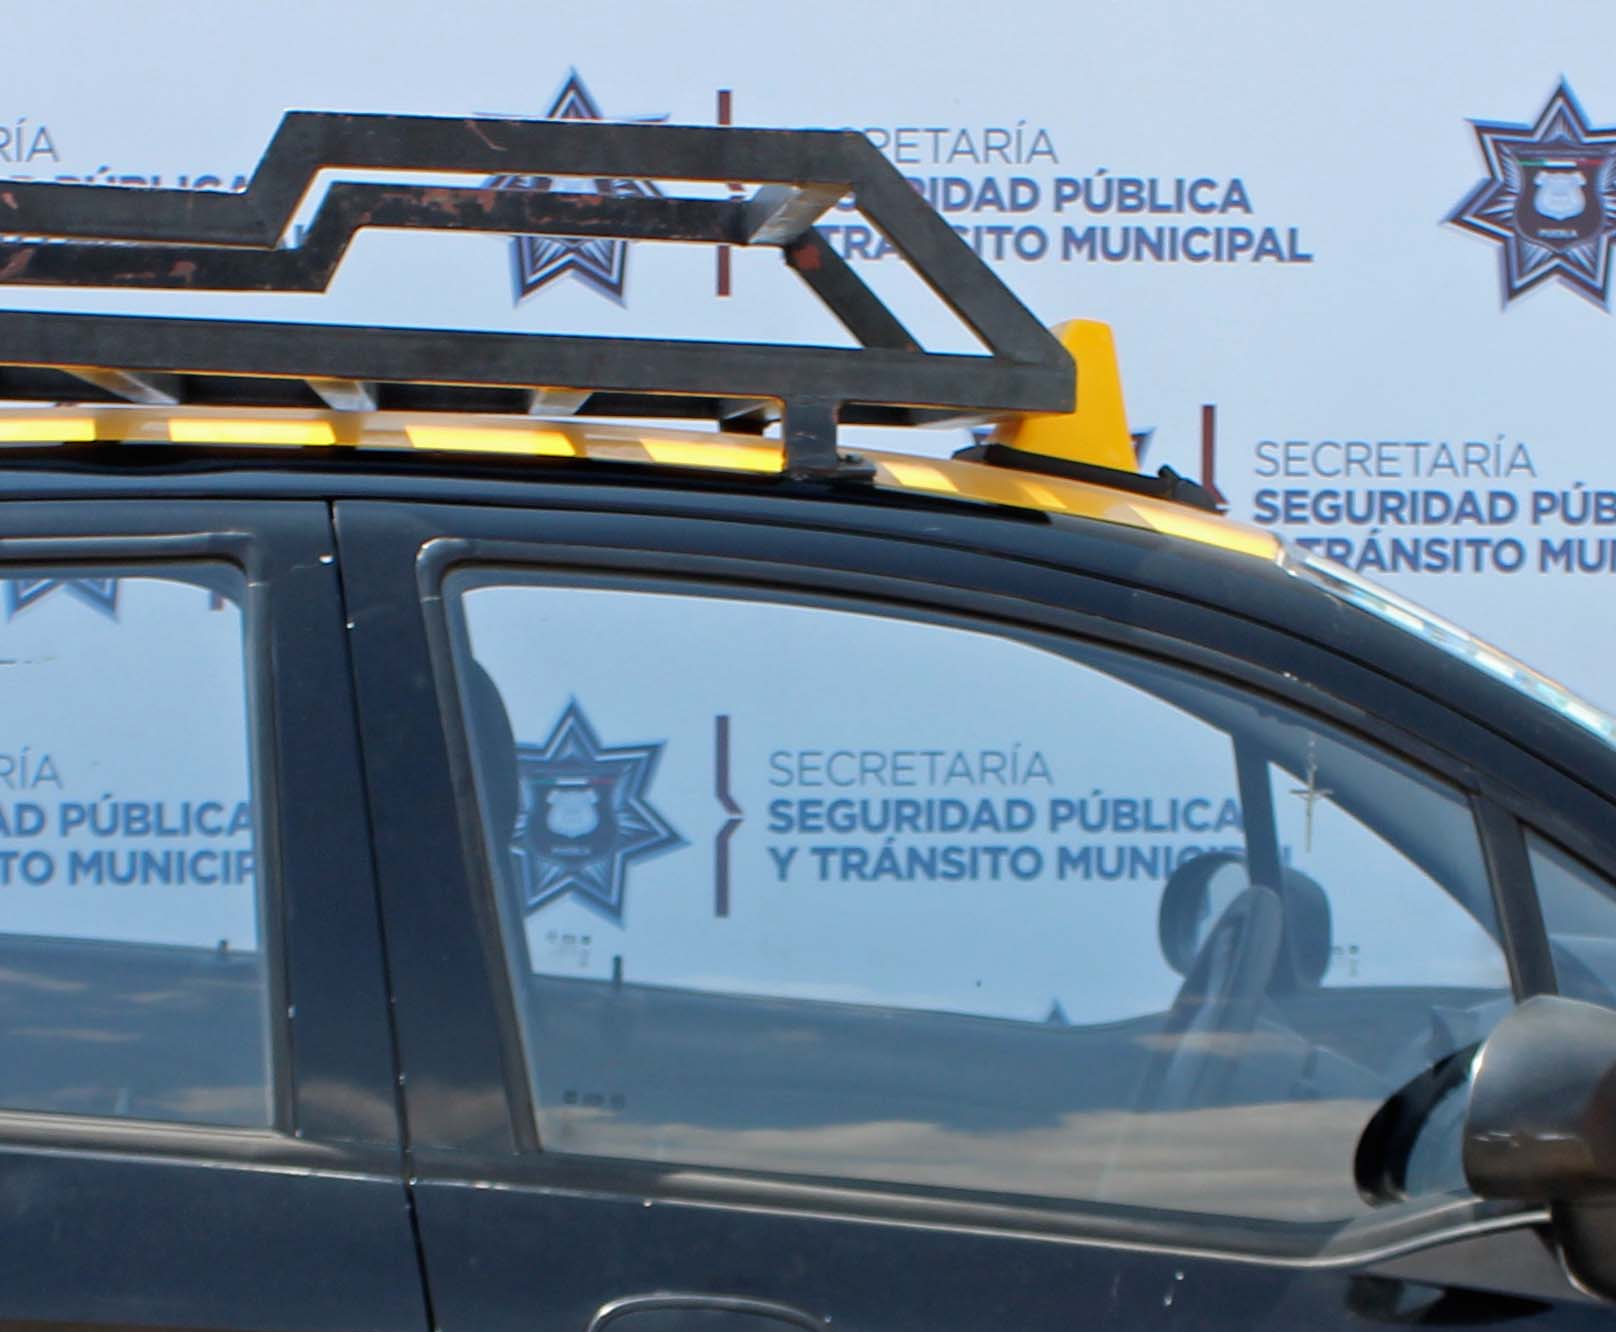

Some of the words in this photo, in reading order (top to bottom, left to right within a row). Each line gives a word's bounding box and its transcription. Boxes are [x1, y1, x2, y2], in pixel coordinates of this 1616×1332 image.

[862, 120, 1061, 164] ETARÍA
[1053, 167, 1253, 214] PÚBLICA
[1061, 225, 1314, 263] MUNICIPAL
[1254, 433, 1537, 478] SECRETARÍA
[1253, 488, 1519, 525] SEGURIDAD
[768, 742, 1054, 788] SECRETARÍA
[57, 794, 252, 839] PÚBLICA
[767, 797, 1036, 835] SEGURIDAD
[1049, 789, 1242, 832] PÚBLICA
[70, 850, 254, 888] MUNICIP
[767, 846, 799, 882] Y
[809, 835, 1045, 882] TRÁNSITO
